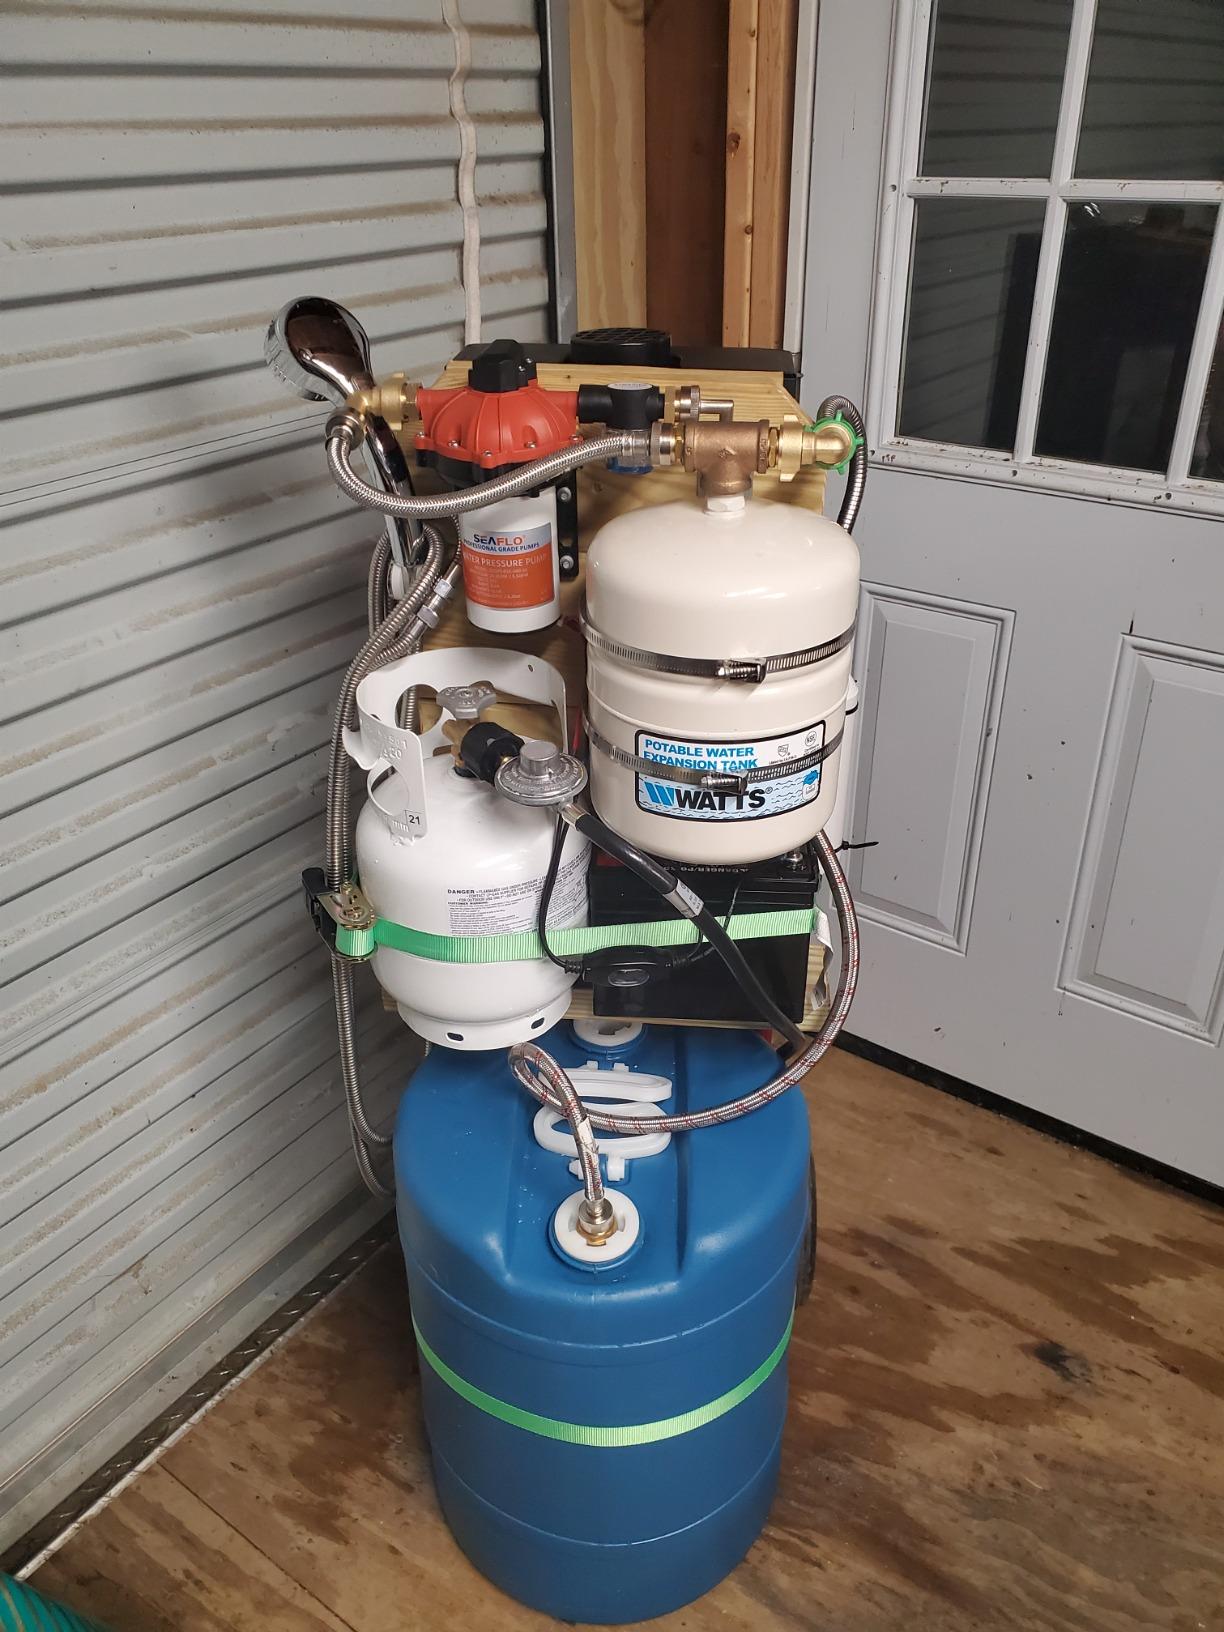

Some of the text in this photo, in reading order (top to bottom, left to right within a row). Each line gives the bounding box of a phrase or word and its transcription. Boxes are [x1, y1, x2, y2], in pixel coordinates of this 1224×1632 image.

[473, 534, 523, 546] SEAFLO
[519, 542, 540, 551] PUMPS
[481, 557, 524, 567] PRESSURE
[645, 738, 754, 757] POTABLE WATER
[643, 751, 717, 771] EXPANSION
[721, 758, 758, 772] TANK
[675, 788, 766, 811] WATTS
[408, 814, 421, 825] 21
